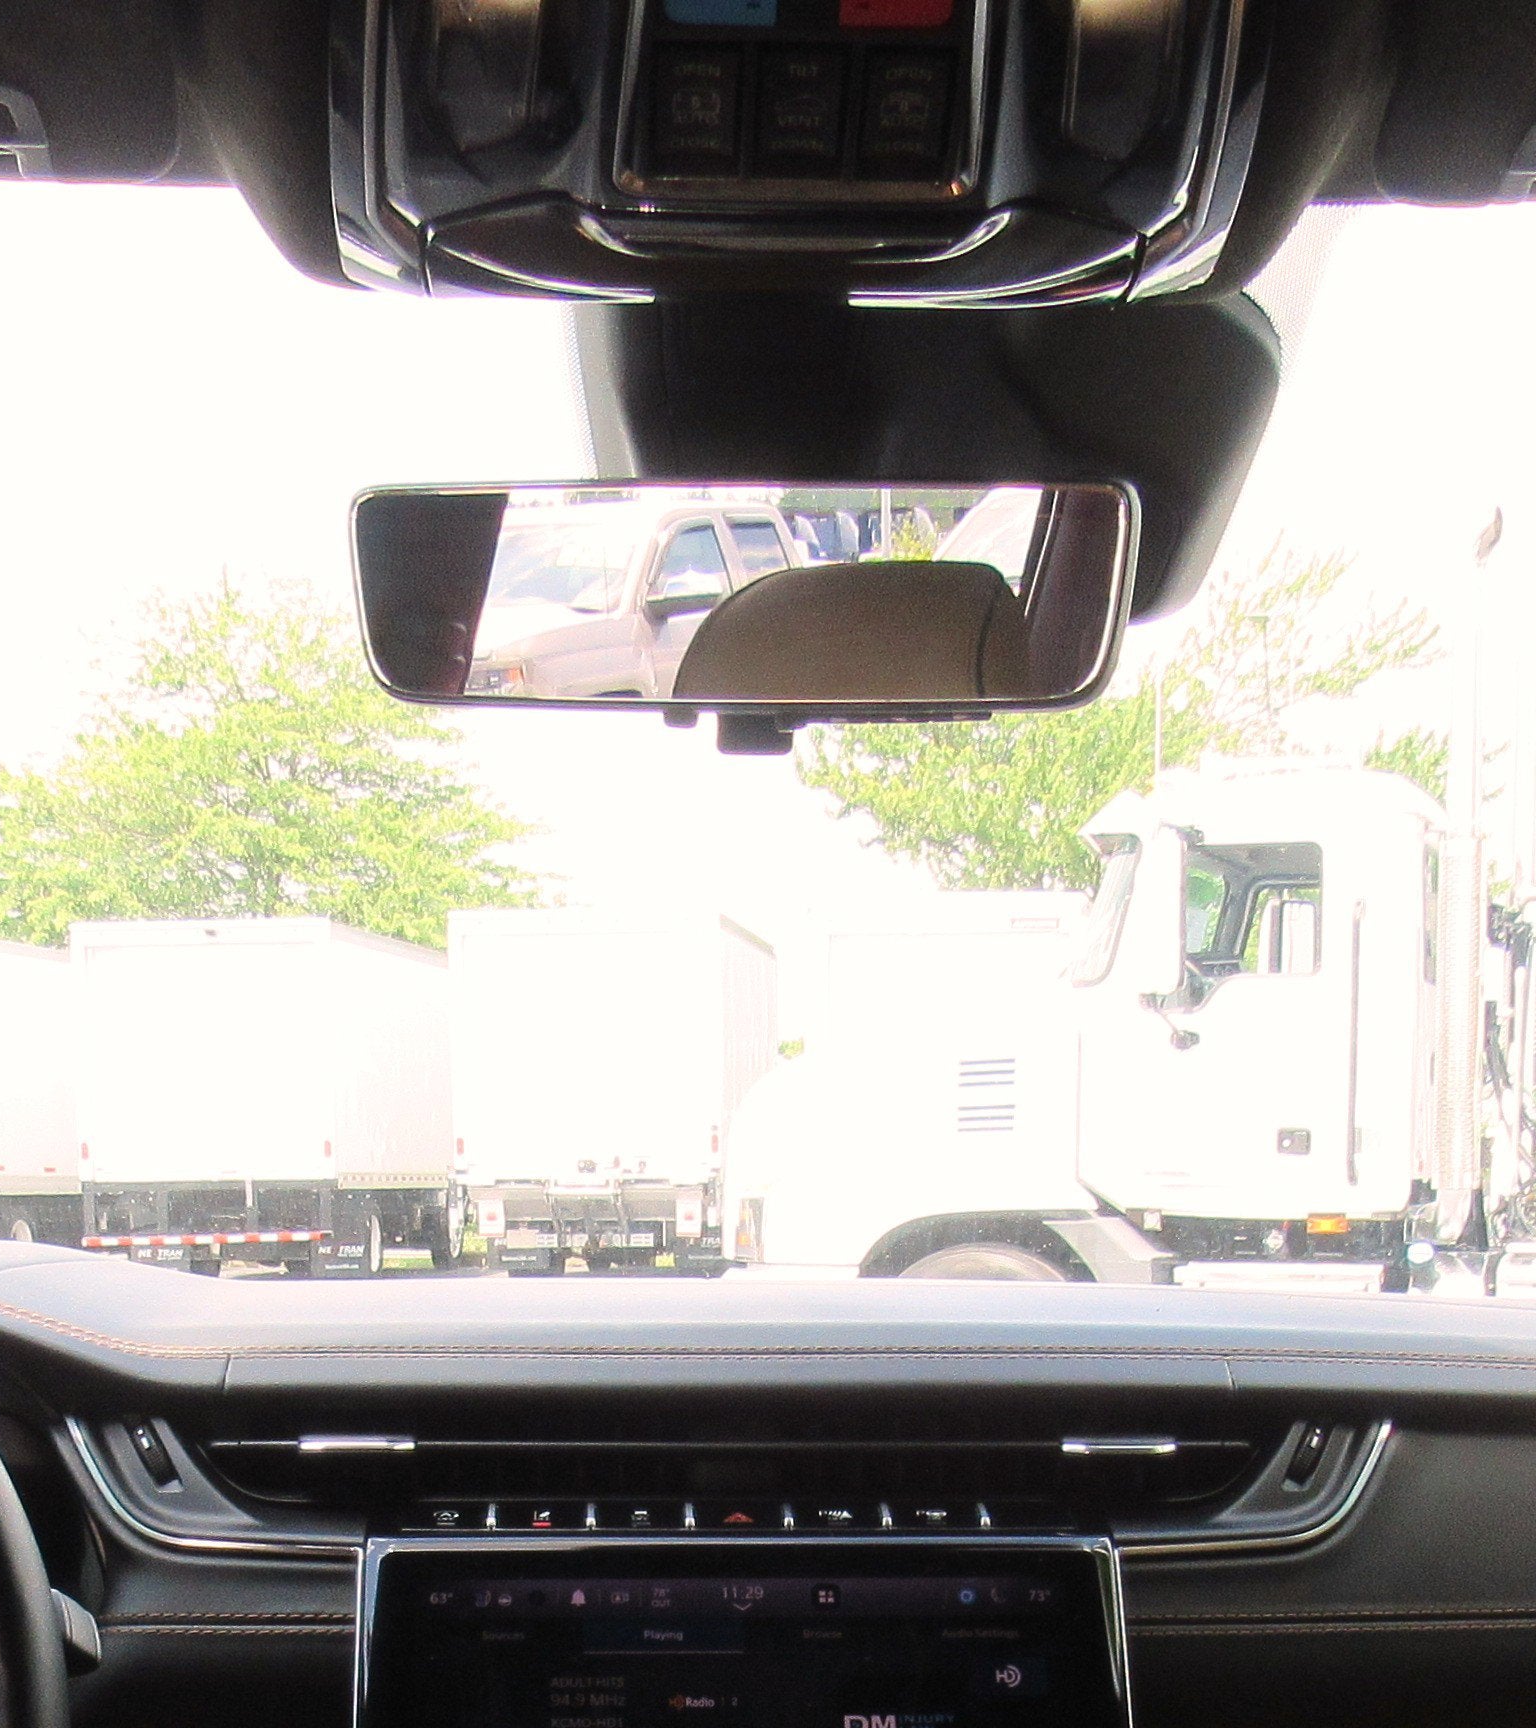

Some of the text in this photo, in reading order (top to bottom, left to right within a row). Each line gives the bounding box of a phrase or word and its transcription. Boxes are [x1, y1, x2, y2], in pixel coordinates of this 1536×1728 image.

[137, 1247, 185, 1260] NETRAN
[318, 1245, 366, 1256] NETRAN
[721, 1585, 766, 1600] 11:29
[643, 1628, 684, 1642] Playing
[684, 1696, 716, 1708] Radio
[897, 1713, 956, 1726] INJURY
